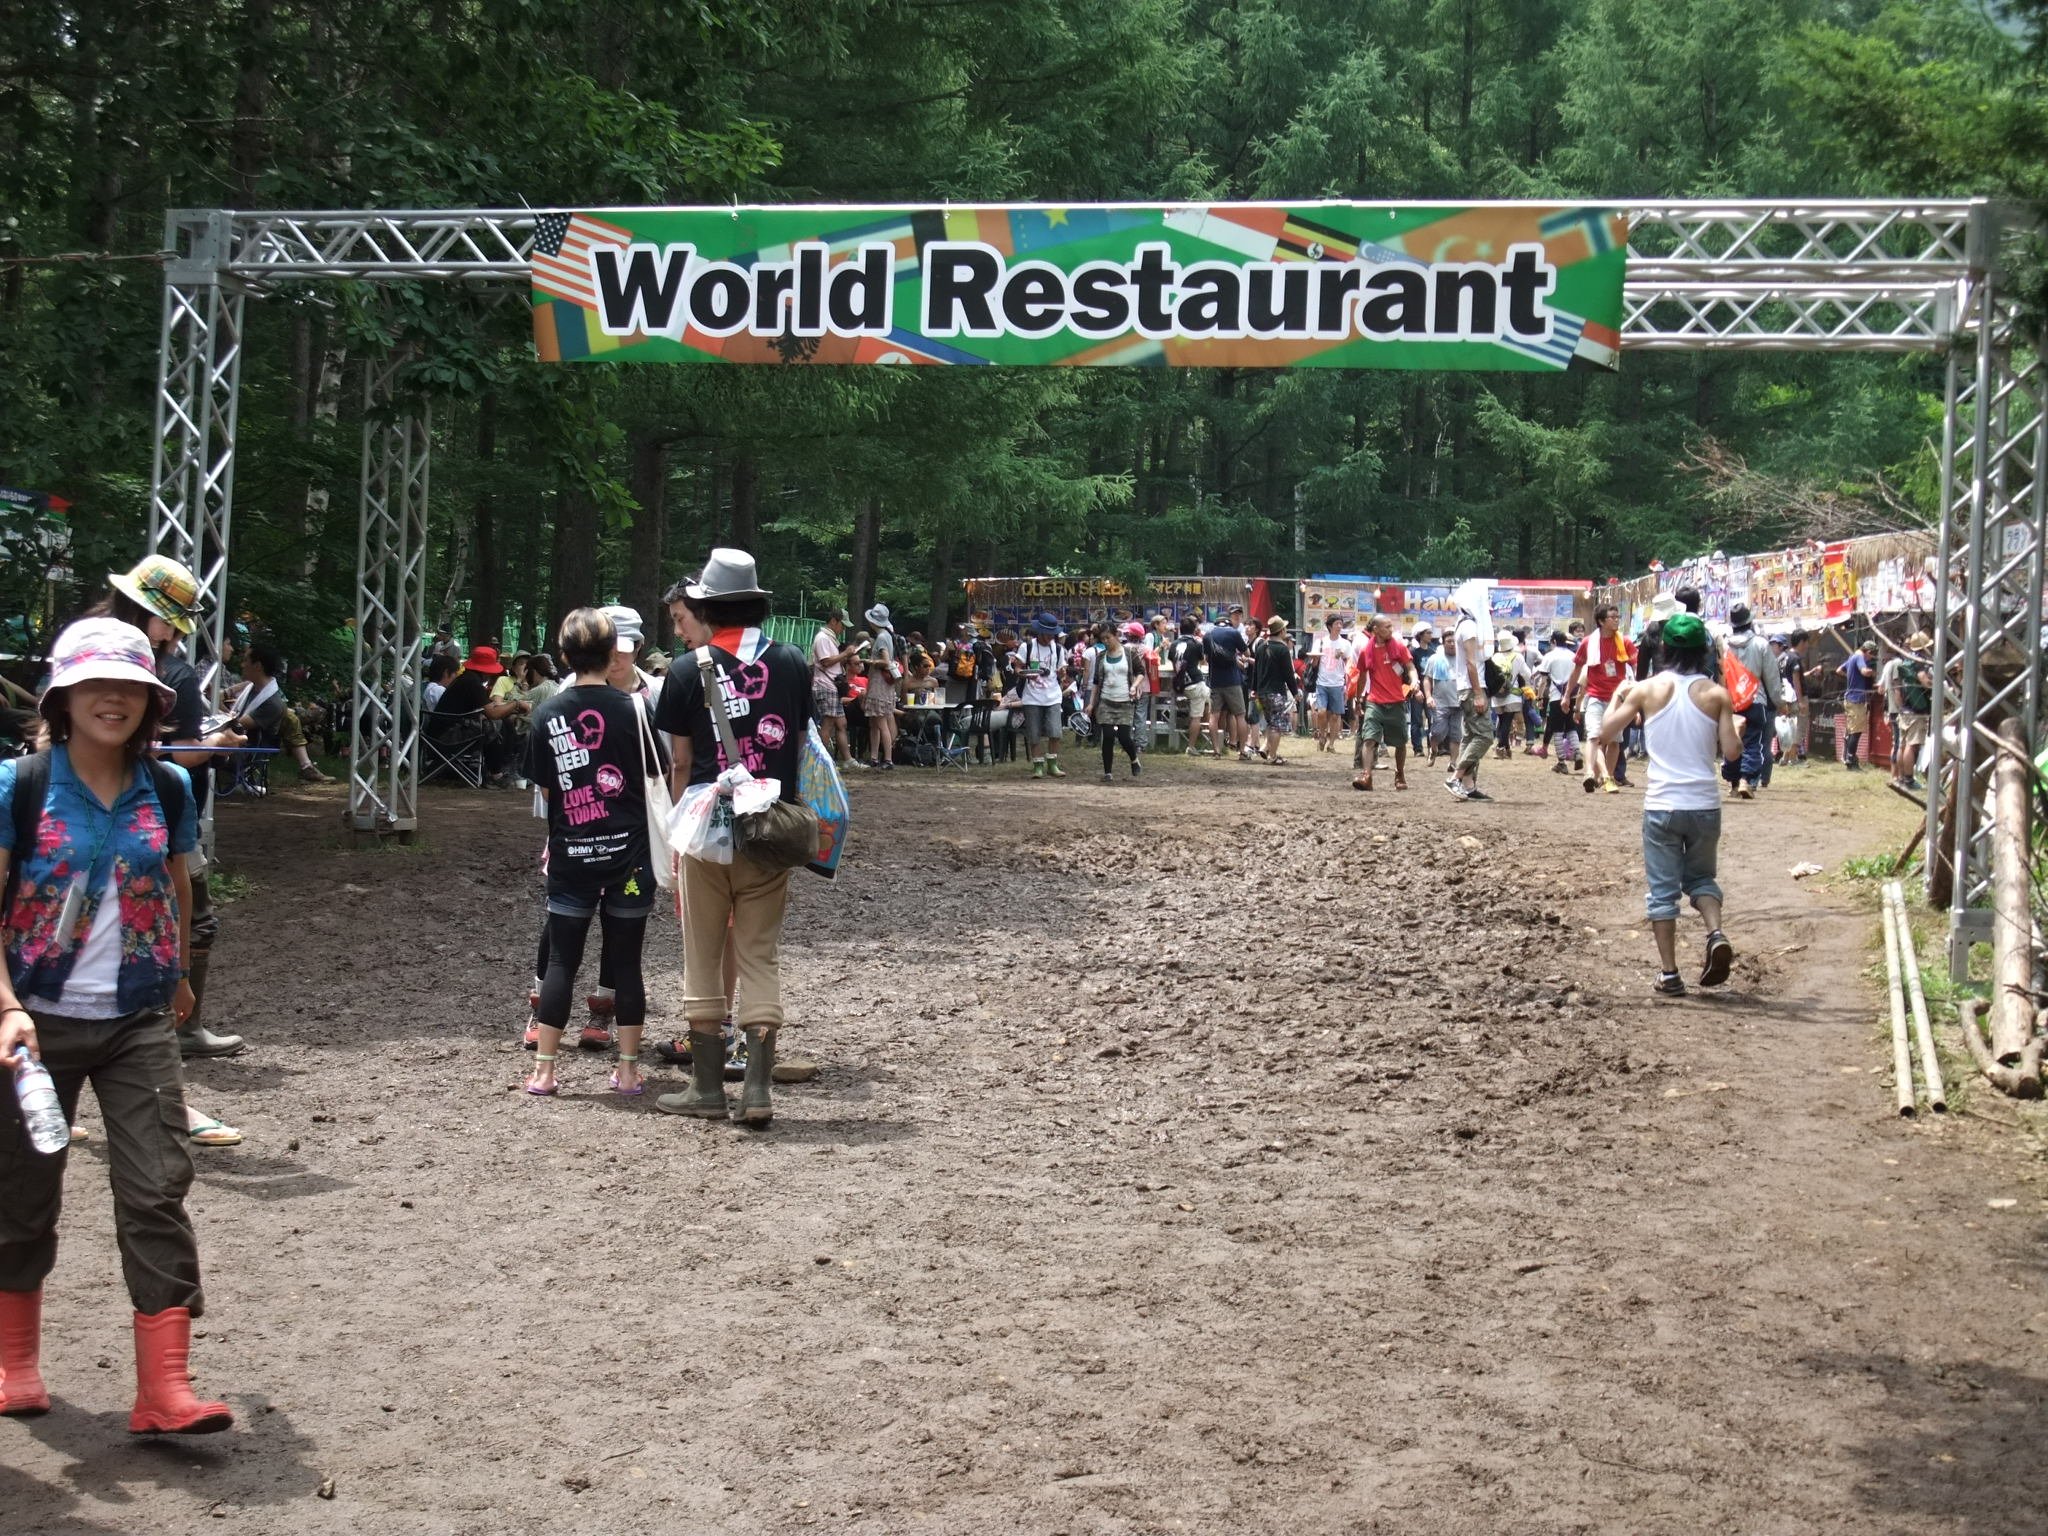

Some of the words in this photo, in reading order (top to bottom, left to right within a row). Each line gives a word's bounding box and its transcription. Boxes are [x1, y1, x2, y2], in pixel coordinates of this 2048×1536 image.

[593, 247, 889, 332] World
[929, 247, 1548, 336] Restaurant
[1023, 581, 1075, 596] QUEEN
[547, 715, 572, 736] ALL
[548, 732, 577, 755] YOU
[555, 748, 590, 774] NEED
[558, 772, 573, 791] IS
[600, 773, 617, 787] 20
[564, 785, 596, 810] LOVE
[565, 800, 610, 827] TODAY.
